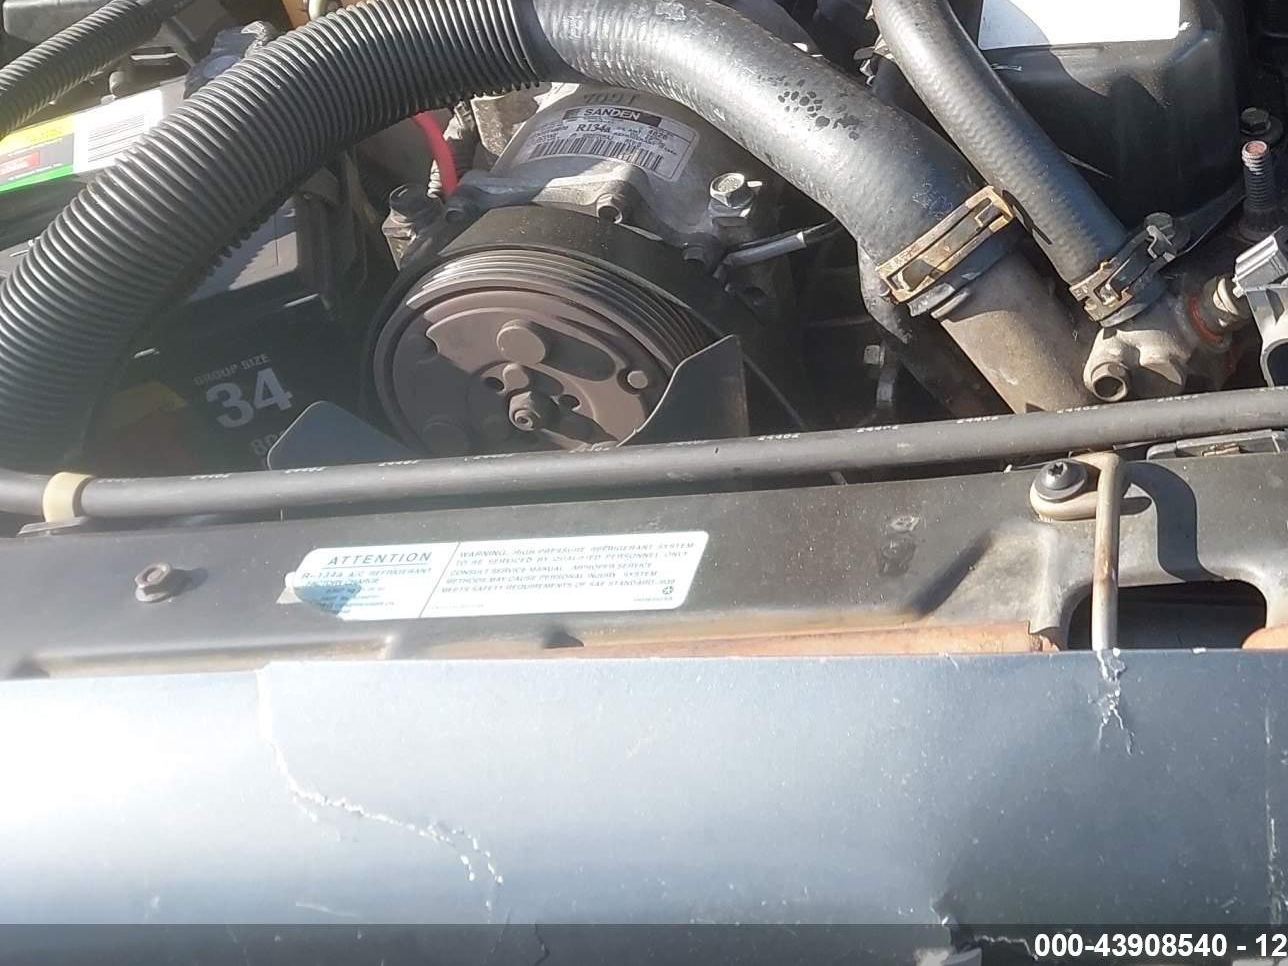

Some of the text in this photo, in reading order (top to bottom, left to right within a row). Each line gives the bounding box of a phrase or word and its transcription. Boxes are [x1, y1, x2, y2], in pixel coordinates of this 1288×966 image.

[583, 108, 641, 120] SANDEN
[575, 124, 611, 133] R134a
[240, 353, 271, 370] SIZE
[206, 367, 293, 427] 34
[657, 542, 694, 550] SYSTEM
[328, 551, 433, 566] ATTENTION
[488, 557, 533, 565] SERVICED
[606, 552, 659, 560] PERSONNEL
[450, 569, 490, 577] CONSULT
[616, 562, 653, 570] SERVICE
[539, 573, 585, 581] PERSONAL
[473, 585, 504, 593] SAFETY
